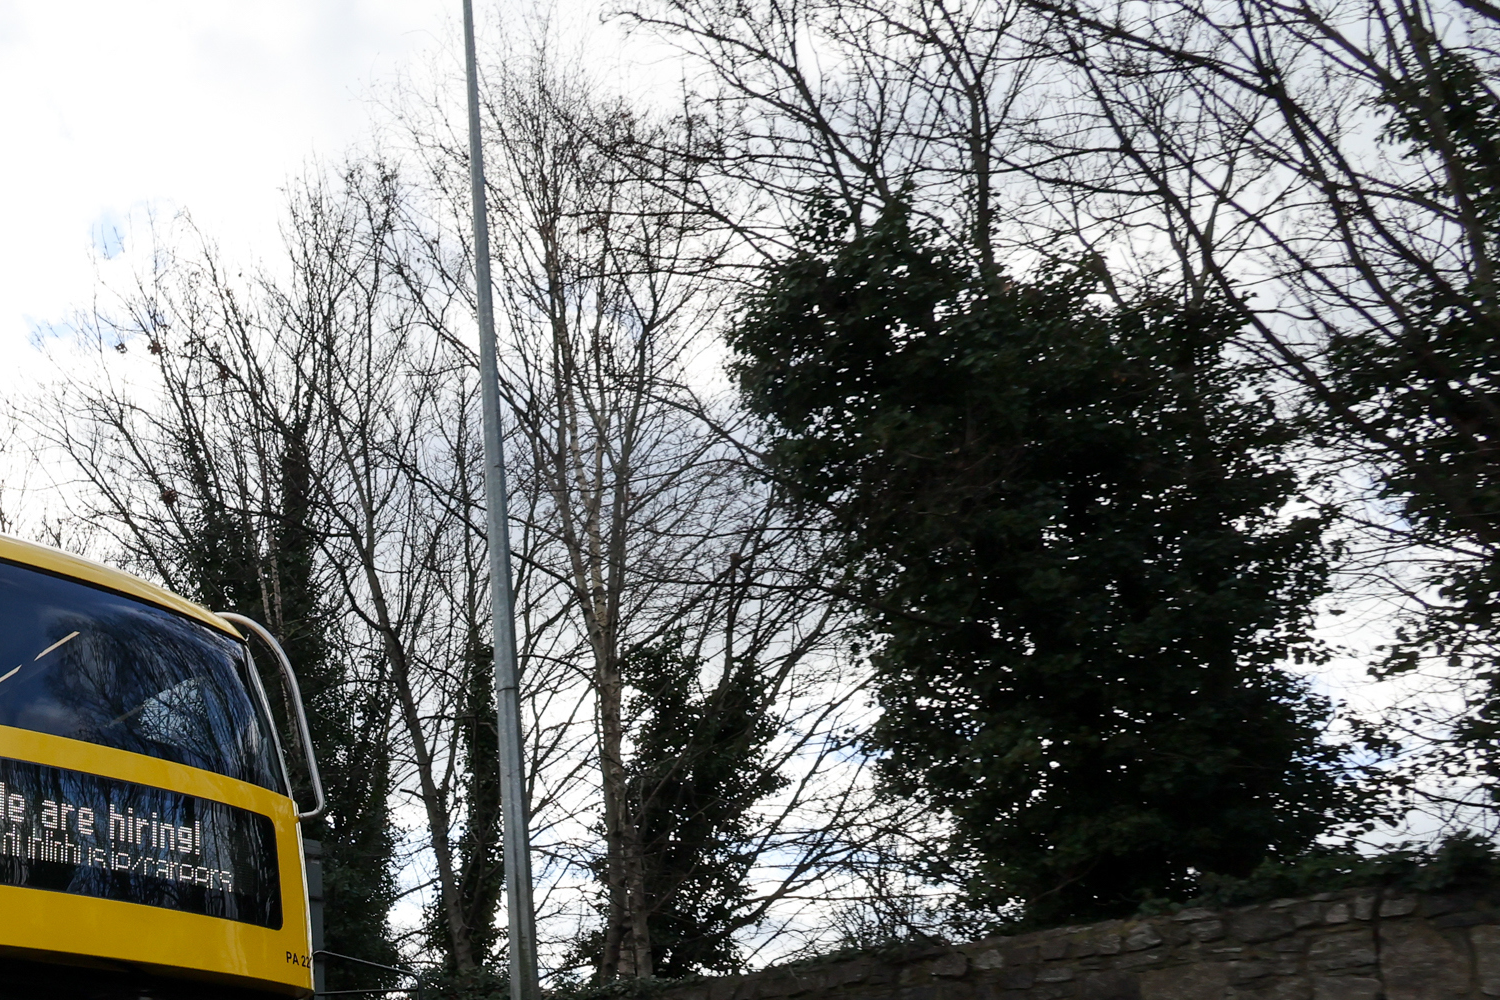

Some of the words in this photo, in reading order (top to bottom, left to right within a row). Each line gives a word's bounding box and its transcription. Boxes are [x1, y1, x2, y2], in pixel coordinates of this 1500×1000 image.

[42, 799, 94, 836] are
[109, 803, 200, 855] hiring!
[286, 951, 299, 966] PA
[301, 955, 312, 969] 22
